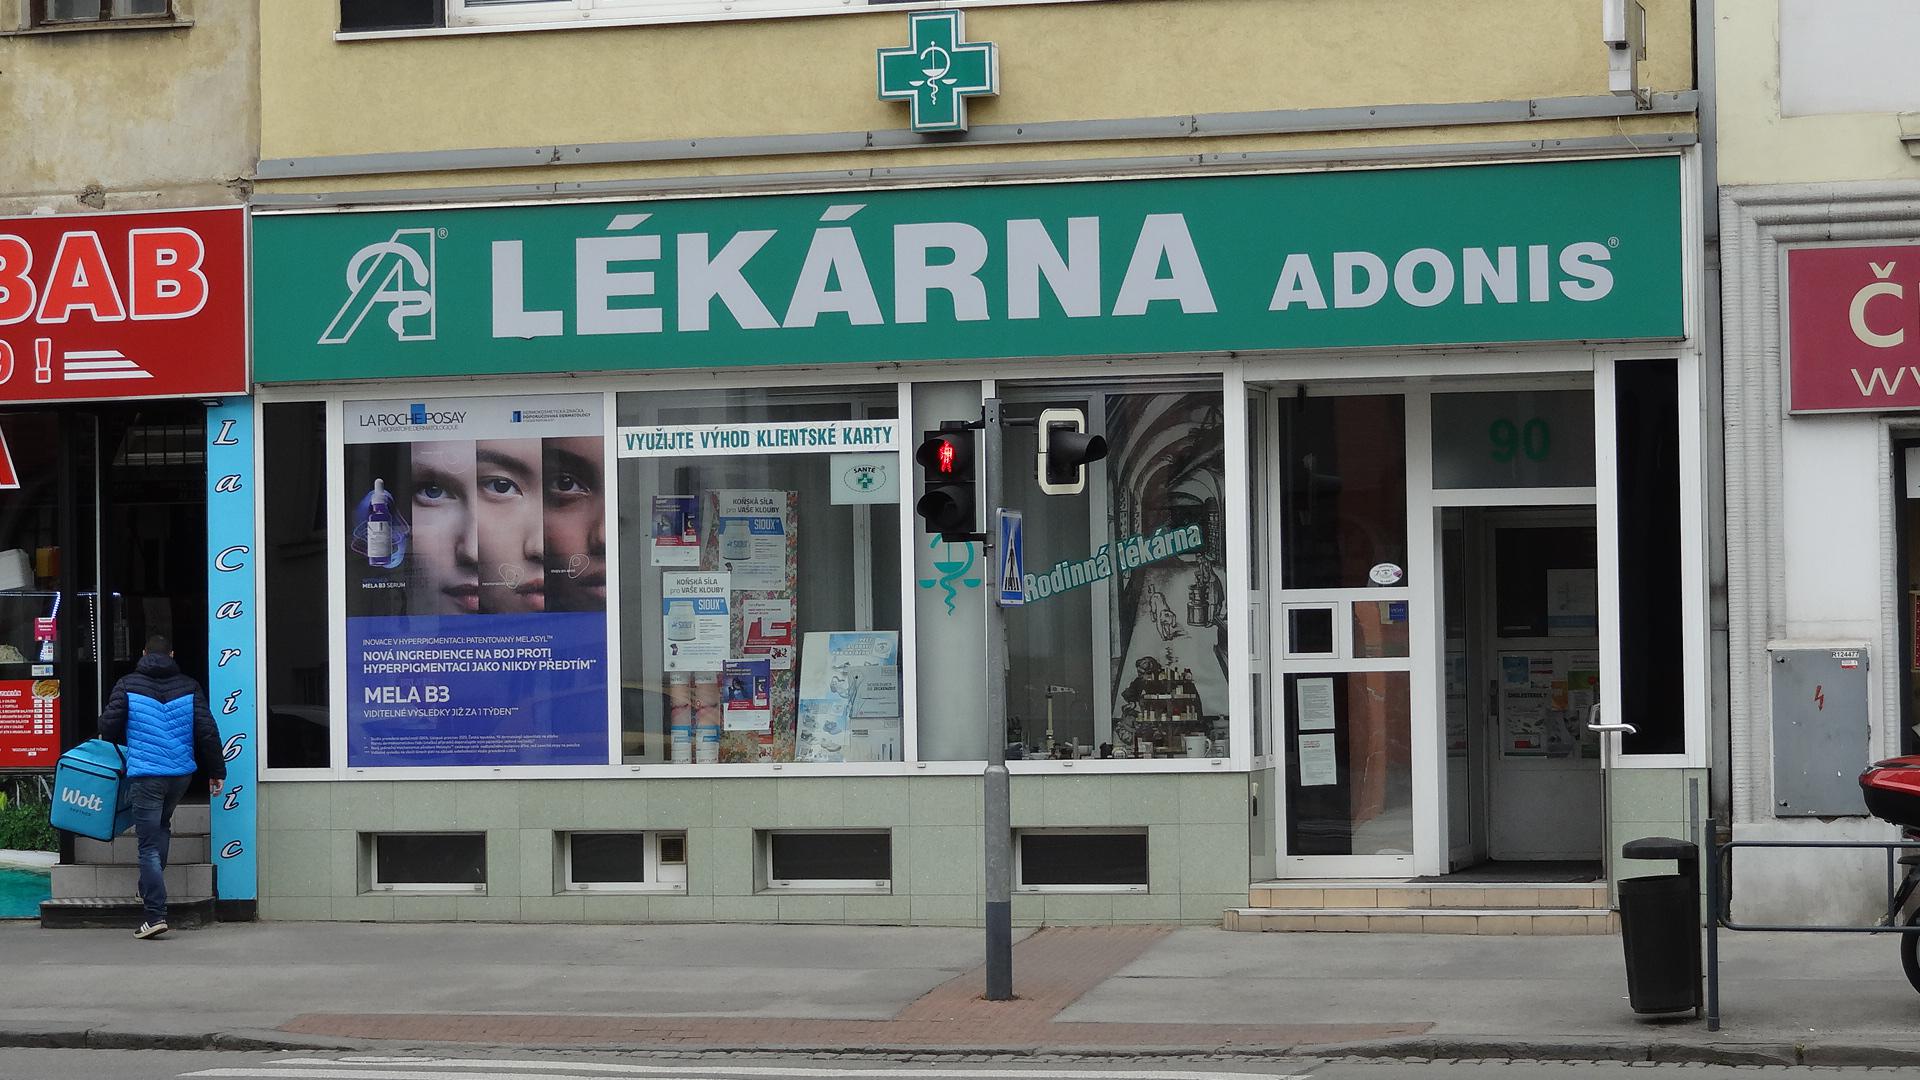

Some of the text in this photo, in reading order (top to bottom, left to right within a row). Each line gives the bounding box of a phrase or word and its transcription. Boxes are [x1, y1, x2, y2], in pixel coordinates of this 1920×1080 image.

[491, 203, 1219, 340] LÉKÁRNA
[1848, 261, 1920, 348] Č
[359, 414, 376, 427] LA
[425, 411, 467, 424] POSAY
[625, 423, 893, 451] VYUŽIJTE VÝHOD KLIENTSKÉ KARTY
[1488, 417, 1551, 463] 90
[759, 496, 774, 505] SÍLA
[737, 505, 753, 514] VAŠE
[754, 506, 780, 514] KLOUBY
[1023, 522, 1202, 602] Rodinná lékárna
[704, 576, 718, 585] SÍLA
[681, 585, 698, 594] VAŠE
[699, 586, 724, 594] KLOUBY
[363, 638, 393, 646] INOVACE
[363, 648, 552, 662] NOVÁ INGREDIENCE NA BOJ PROTI
[363, 663, 470, 674] HYPERPIGMENTACI
[472, 661, 500, 672] JAKO
[502, 661, 538, 671] NIKDY
[364, 685, 450, 704] MELA B3
[363, 708, 408, 718] VIDITELNÉ
[408, 707, 450, 718] VÝSLEDKY
[452, 706, 464, 717] JIŽ
[465, 707, 477, 717] ZA
[62, 787, 103, 811] Wolt
